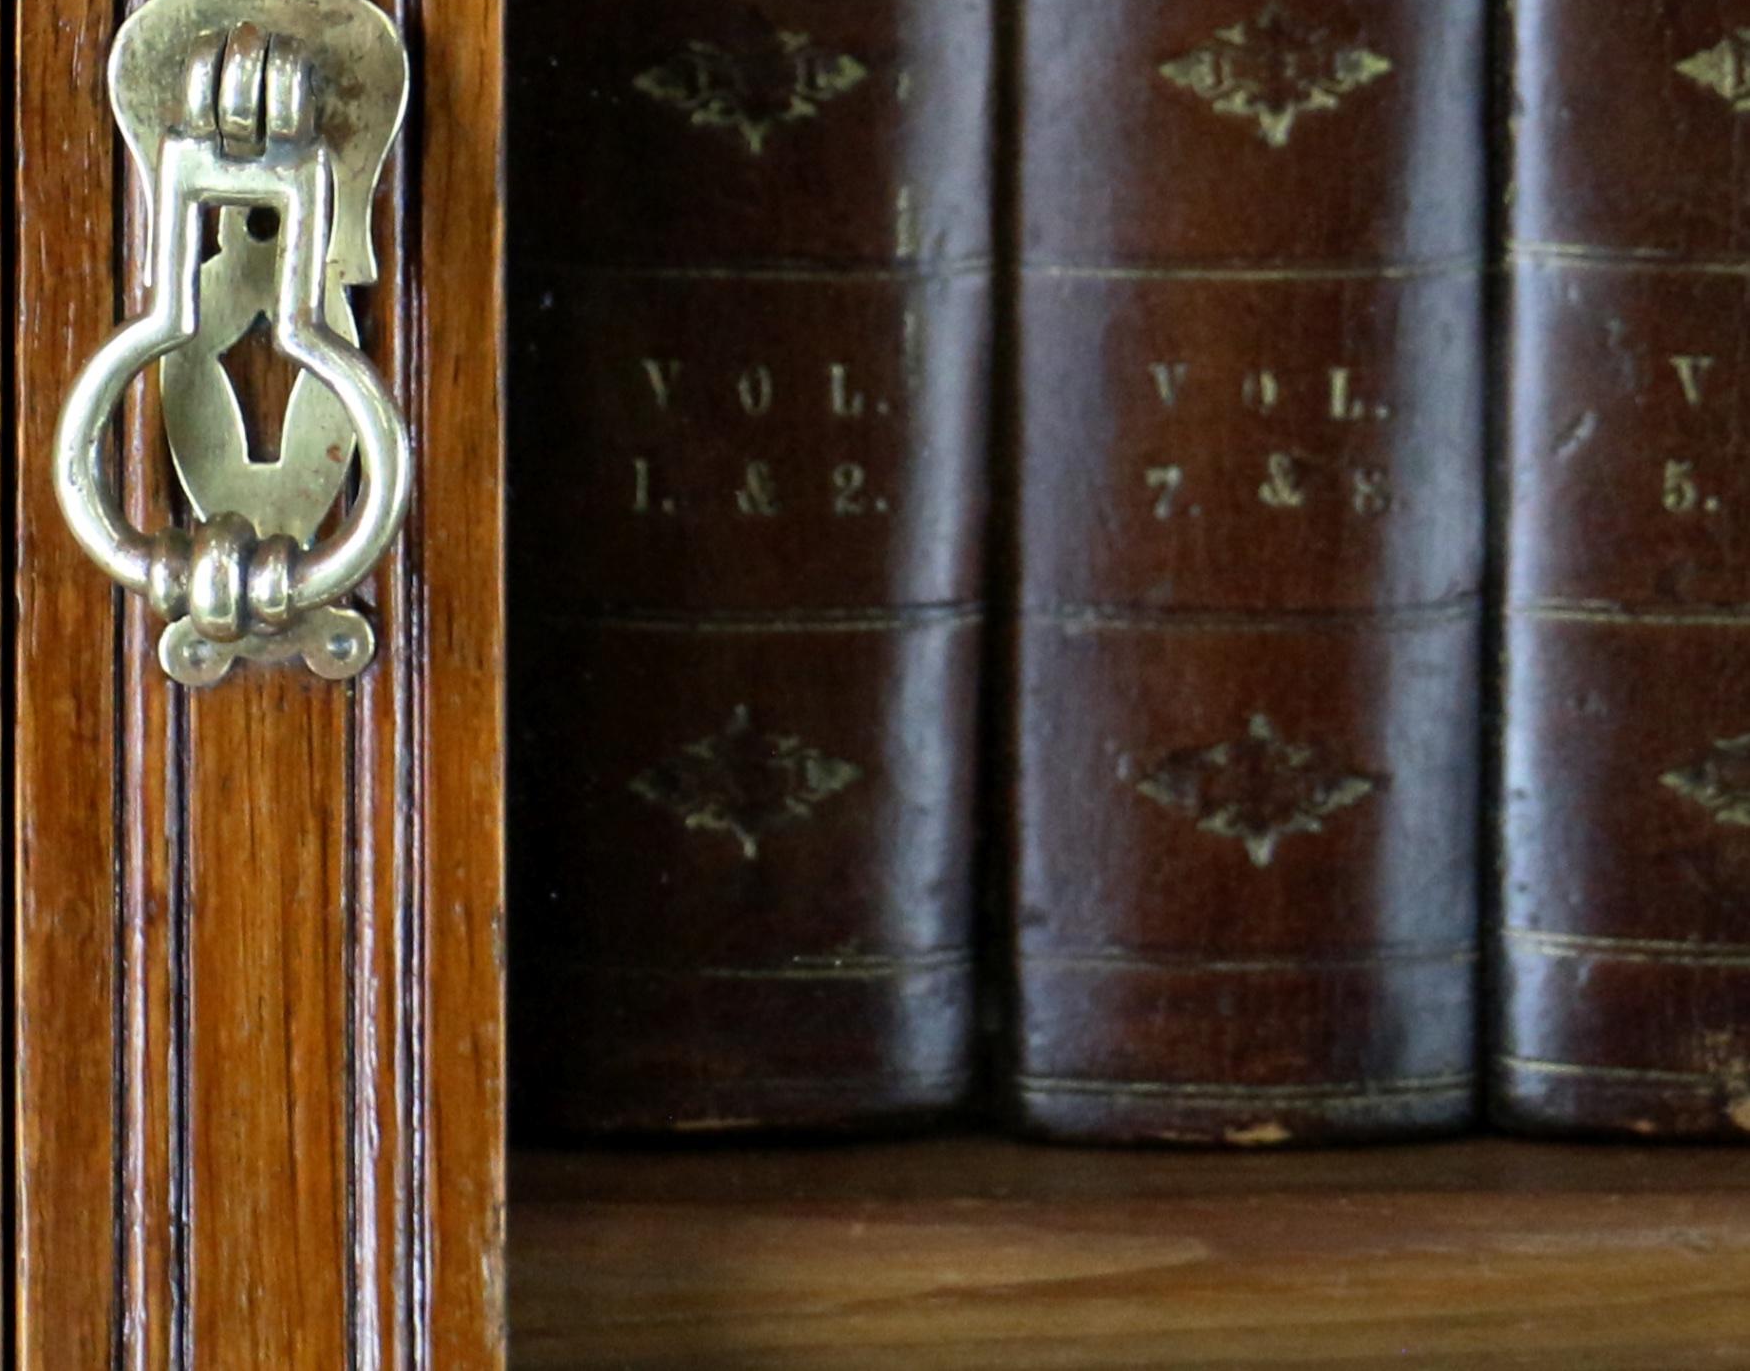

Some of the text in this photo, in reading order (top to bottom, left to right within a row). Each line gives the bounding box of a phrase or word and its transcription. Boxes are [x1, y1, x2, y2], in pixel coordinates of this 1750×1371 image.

[641, 356, 891, 419] VOL.
[733, 458, 778, 519] &
[830, 461, 890, 519] 2.
[1257, 450, 1306, 508] &
